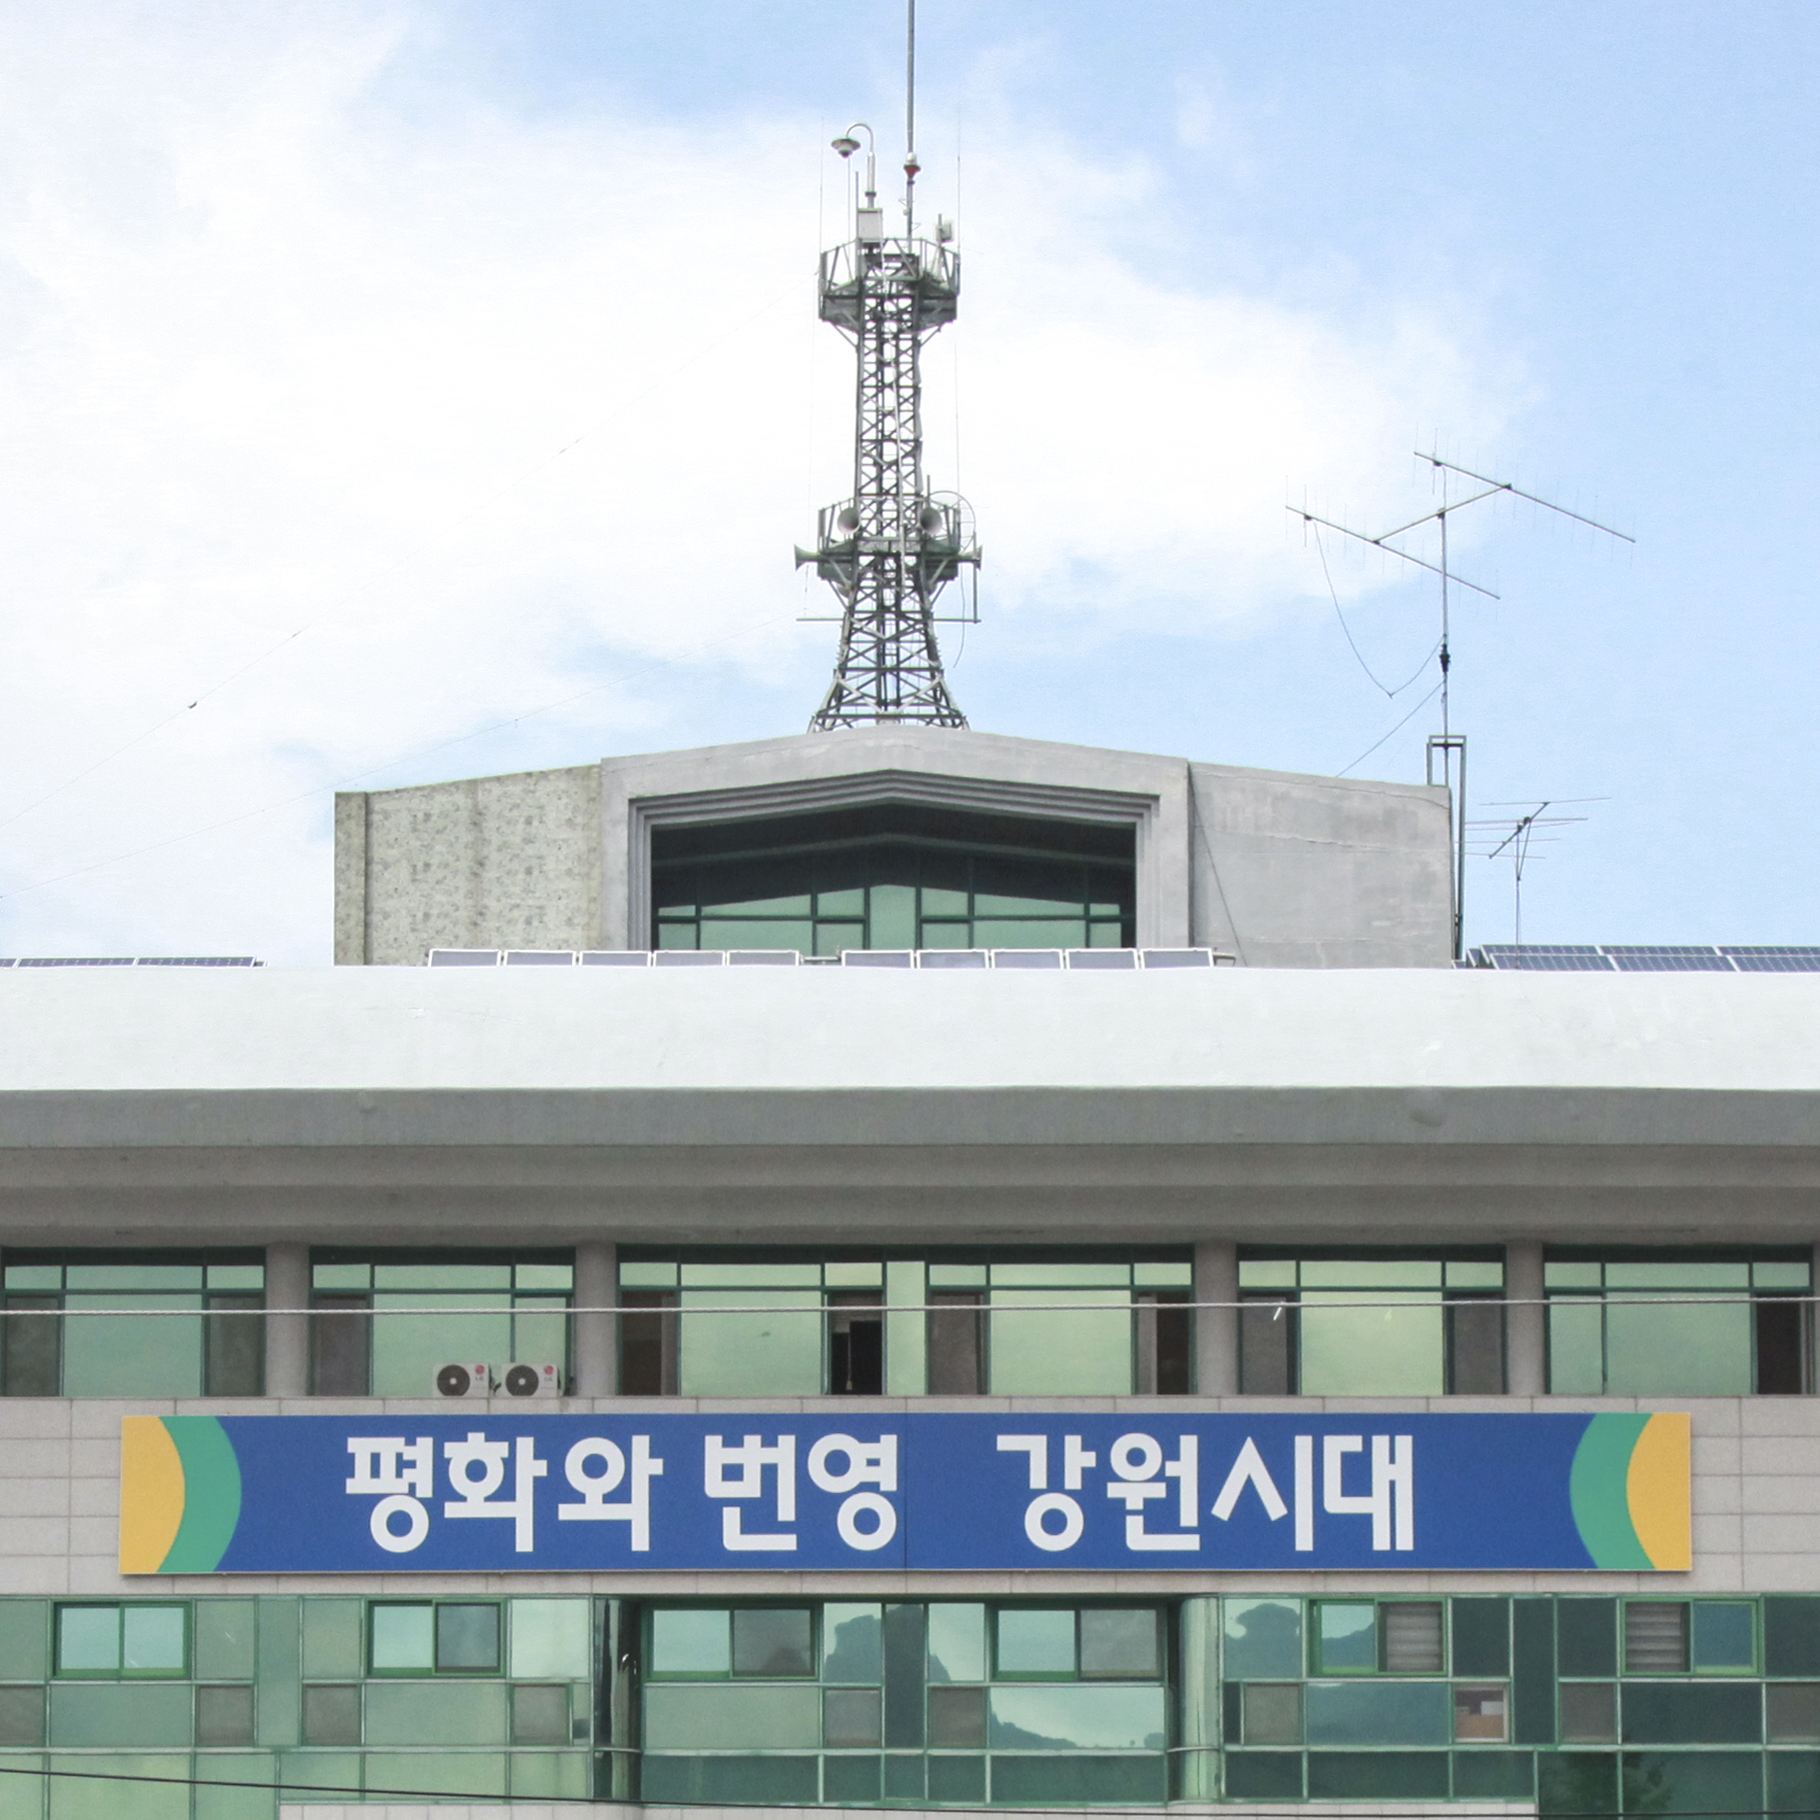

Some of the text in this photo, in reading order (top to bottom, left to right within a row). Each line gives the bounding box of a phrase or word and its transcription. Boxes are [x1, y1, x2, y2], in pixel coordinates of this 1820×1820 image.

[345, 1431, 1414, 1552] 평화와 번영 강원시대
